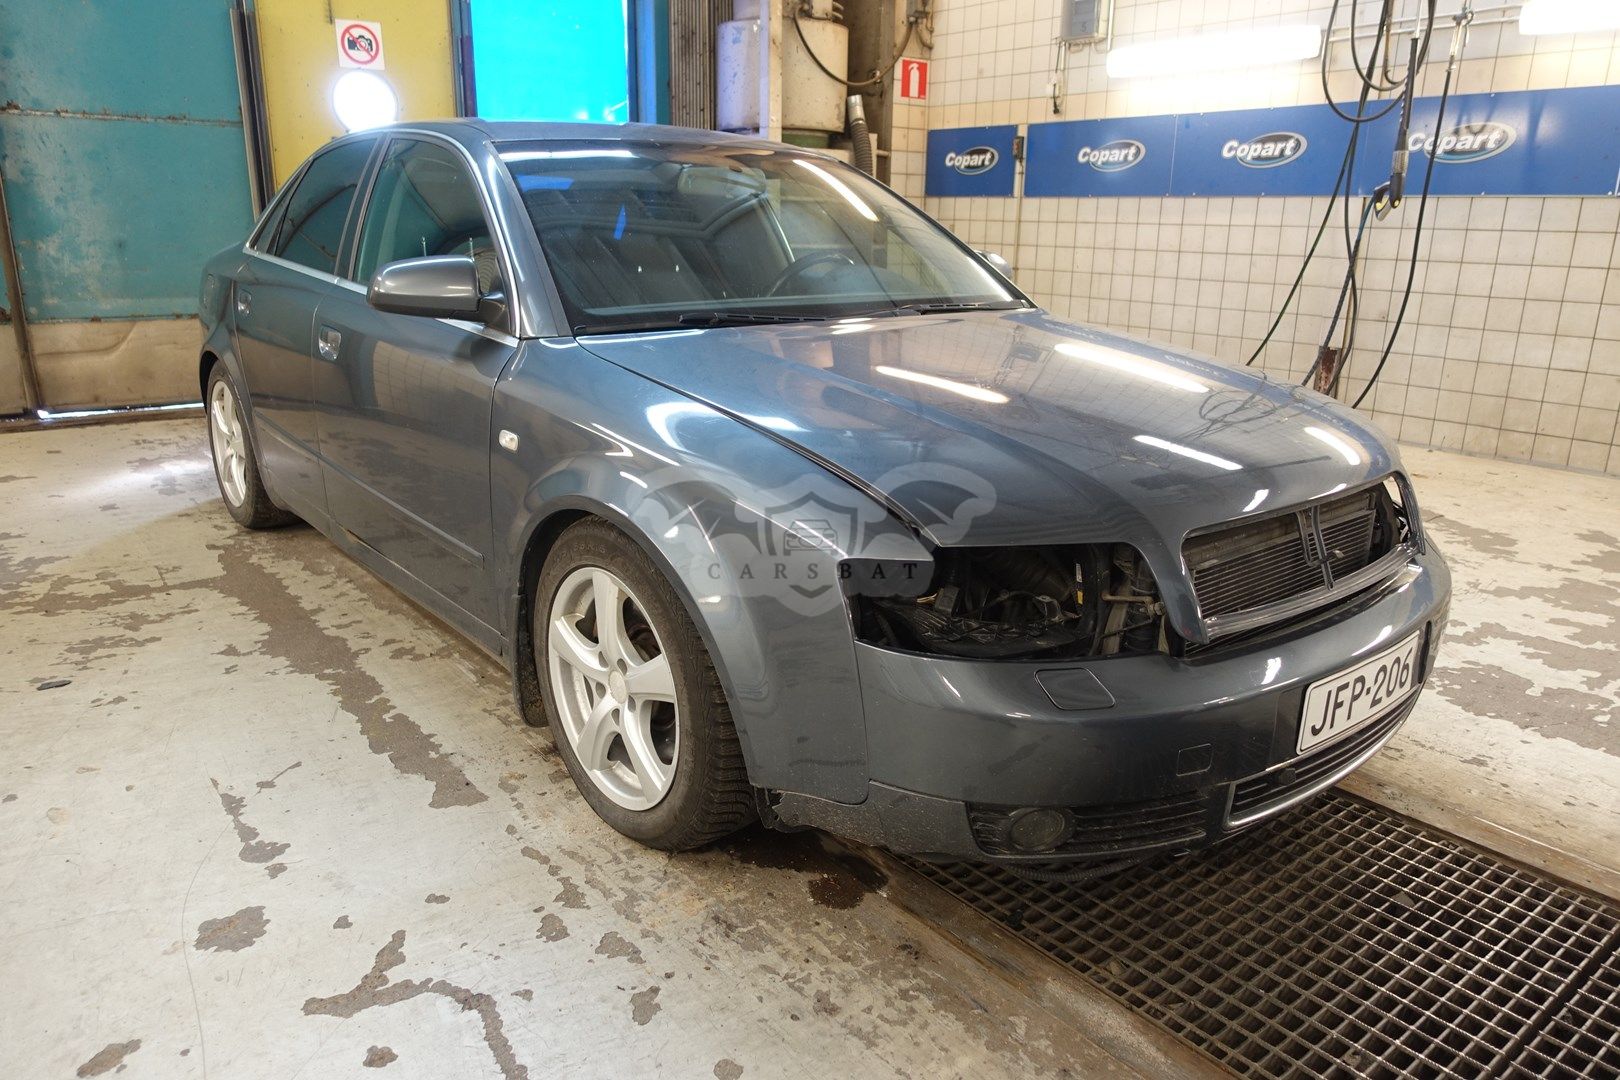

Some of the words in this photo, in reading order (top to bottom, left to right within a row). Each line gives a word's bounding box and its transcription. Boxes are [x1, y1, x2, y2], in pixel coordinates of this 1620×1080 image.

[1221, 139, 1297, 161] Copart
[1407, 127, 1501, 155] Copart
[945, 151, 992, 169] Copart
[1077, 145, 1137, 166] Copart
[1310, 646, 1414, 737] JFP-206
